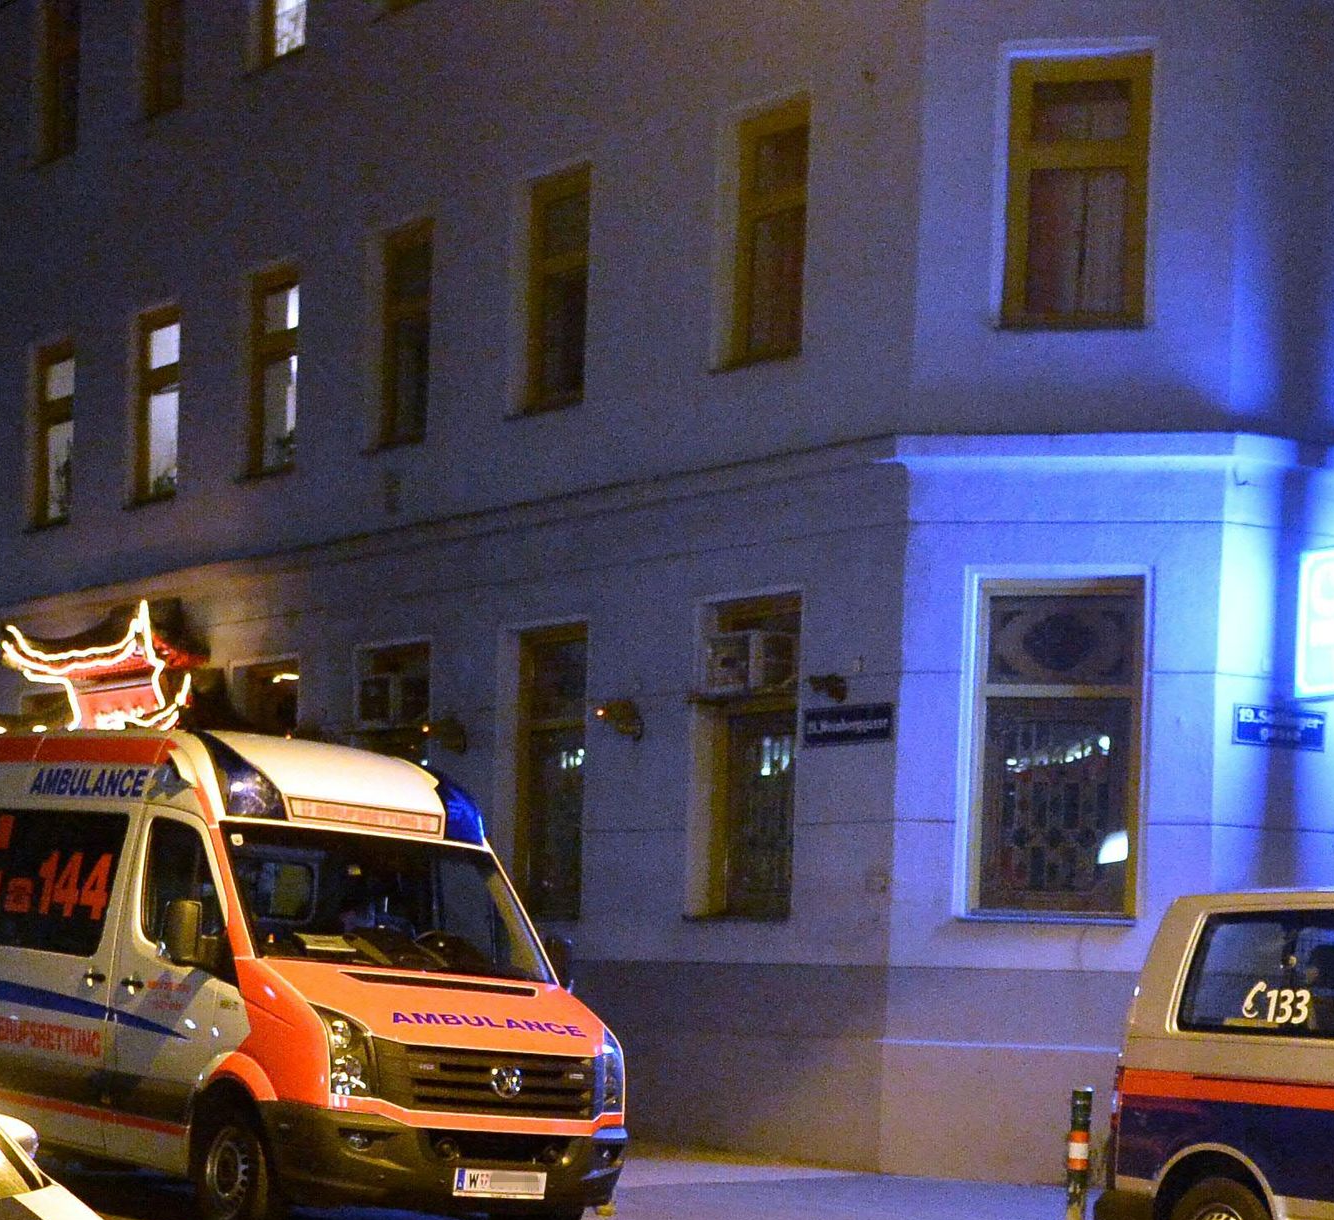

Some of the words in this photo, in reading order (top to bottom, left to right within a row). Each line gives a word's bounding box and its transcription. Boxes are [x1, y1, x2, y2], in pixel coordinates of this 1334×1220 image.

[30, 768, 149, 797] AMBULANCE
[38, 850, 113, 921] 144
[1267, 989, 1311, 1024] 133
[392, 1012, 588, 1038] AMBULANCE
